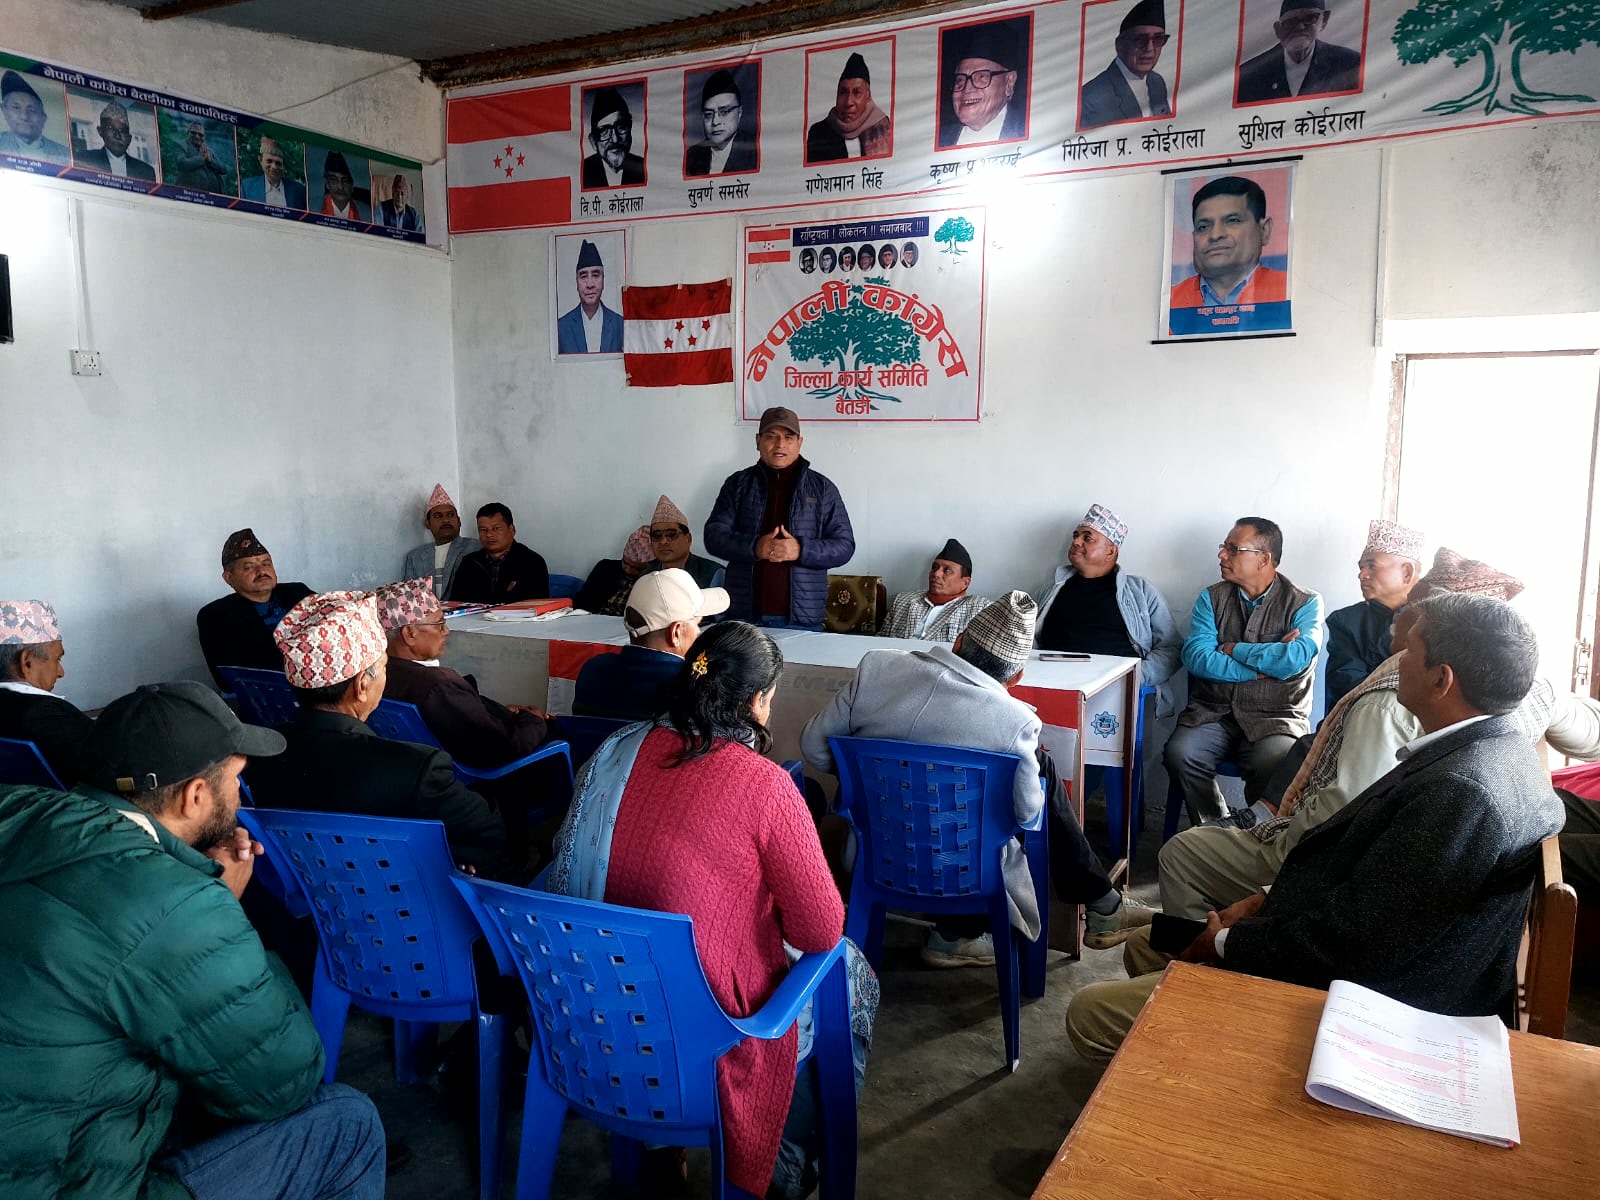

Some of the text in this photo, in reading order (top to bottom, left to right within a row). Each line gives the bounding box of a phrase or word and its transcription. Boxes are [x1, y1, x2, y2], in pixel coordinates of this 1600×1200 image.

[43, 67, 86, 87] नेपाली
[89, 79, 127, 97] कांग्रेस
[131, 87, 175, 109] बैतडीका
[1239, 106, 1366, 149] सुशिल कोईराला
[1063, 136, 1109, 162] गिरिजा
[1142, 124, 1206, 152] कोईराला
[805, 167, 884, 194] गणेशमान सिंह
[929, 161, 961, 184] कृष्ण
[580, 192, 644, 216] वि.पी. कोईराला
[688, 179, 750, 208] सुवर्ण समसेर
[838, 224, 867, 239] लोकतन्त्र
[880, 222, 912, 234] समाजवाद
[747, 280, 969, 383] नेपाली कांग्रेस
[784, 363, 930, 388] जिल्ला कार्य समिति
[835, 394, 871, 415] बैतडी
